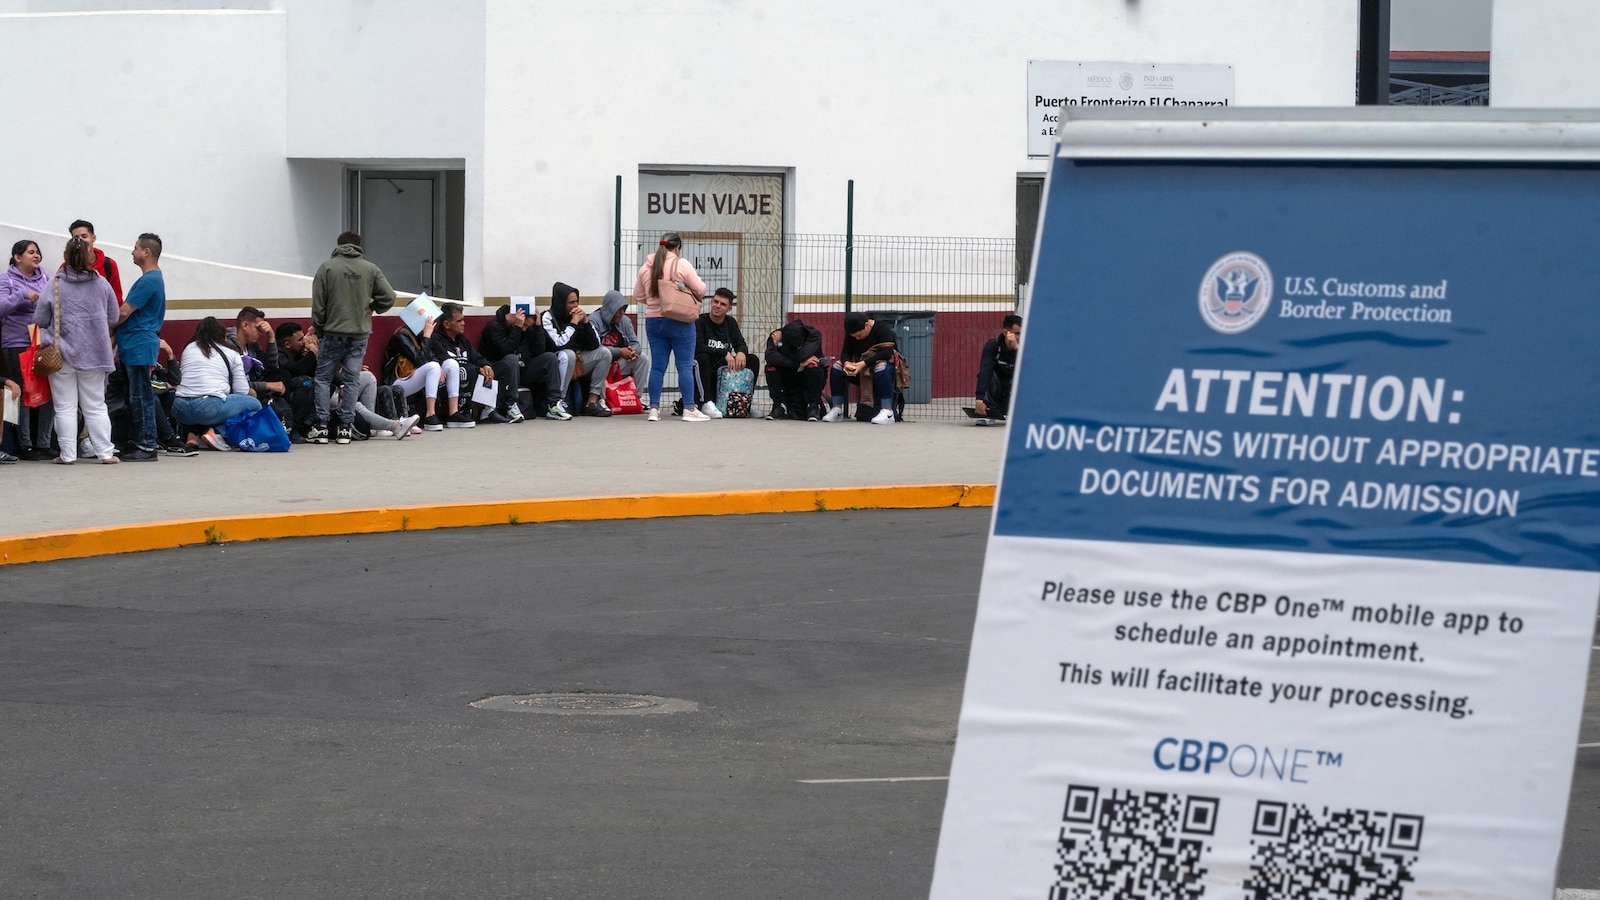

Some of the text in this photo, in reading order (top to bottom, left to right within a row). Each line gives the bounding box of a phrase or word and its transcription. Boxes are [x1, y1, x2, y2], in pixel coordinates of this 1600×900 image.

[1035, 95, 1078, 107] Puerto
[1081, 95, 1146, 107] Fronterizo
[647, 192, 772, 216] BUEN VIAJE
[1279, 299, 1452, 323] Border Protection
[1284, 276, 1448, 300] U.S. Customs and
[1154, 368, 1465, 424] ATTENTION:
[1025, 423, 1600, 477] NON-CITIZENS WITHOUT APPROPRIATE
[1079, 467, 1520, 518] DOCUMENTS FOR ADMISSION
[1041, 580, 1116, 605] Please
[1123, 590, 1163, 608] use
[1170, 588, 1208, 612] the
[1216, 591, 1268, 614] CBP
[1351, 603, 1435, 627] mobile
[1443, 612, 1490, 636] app
[1498, 611, 1524, 634] to
[1114, 621, 1424, 663] schedule an appointment.
[1059, 662, 1474, 718] This will facilitate your processing.
